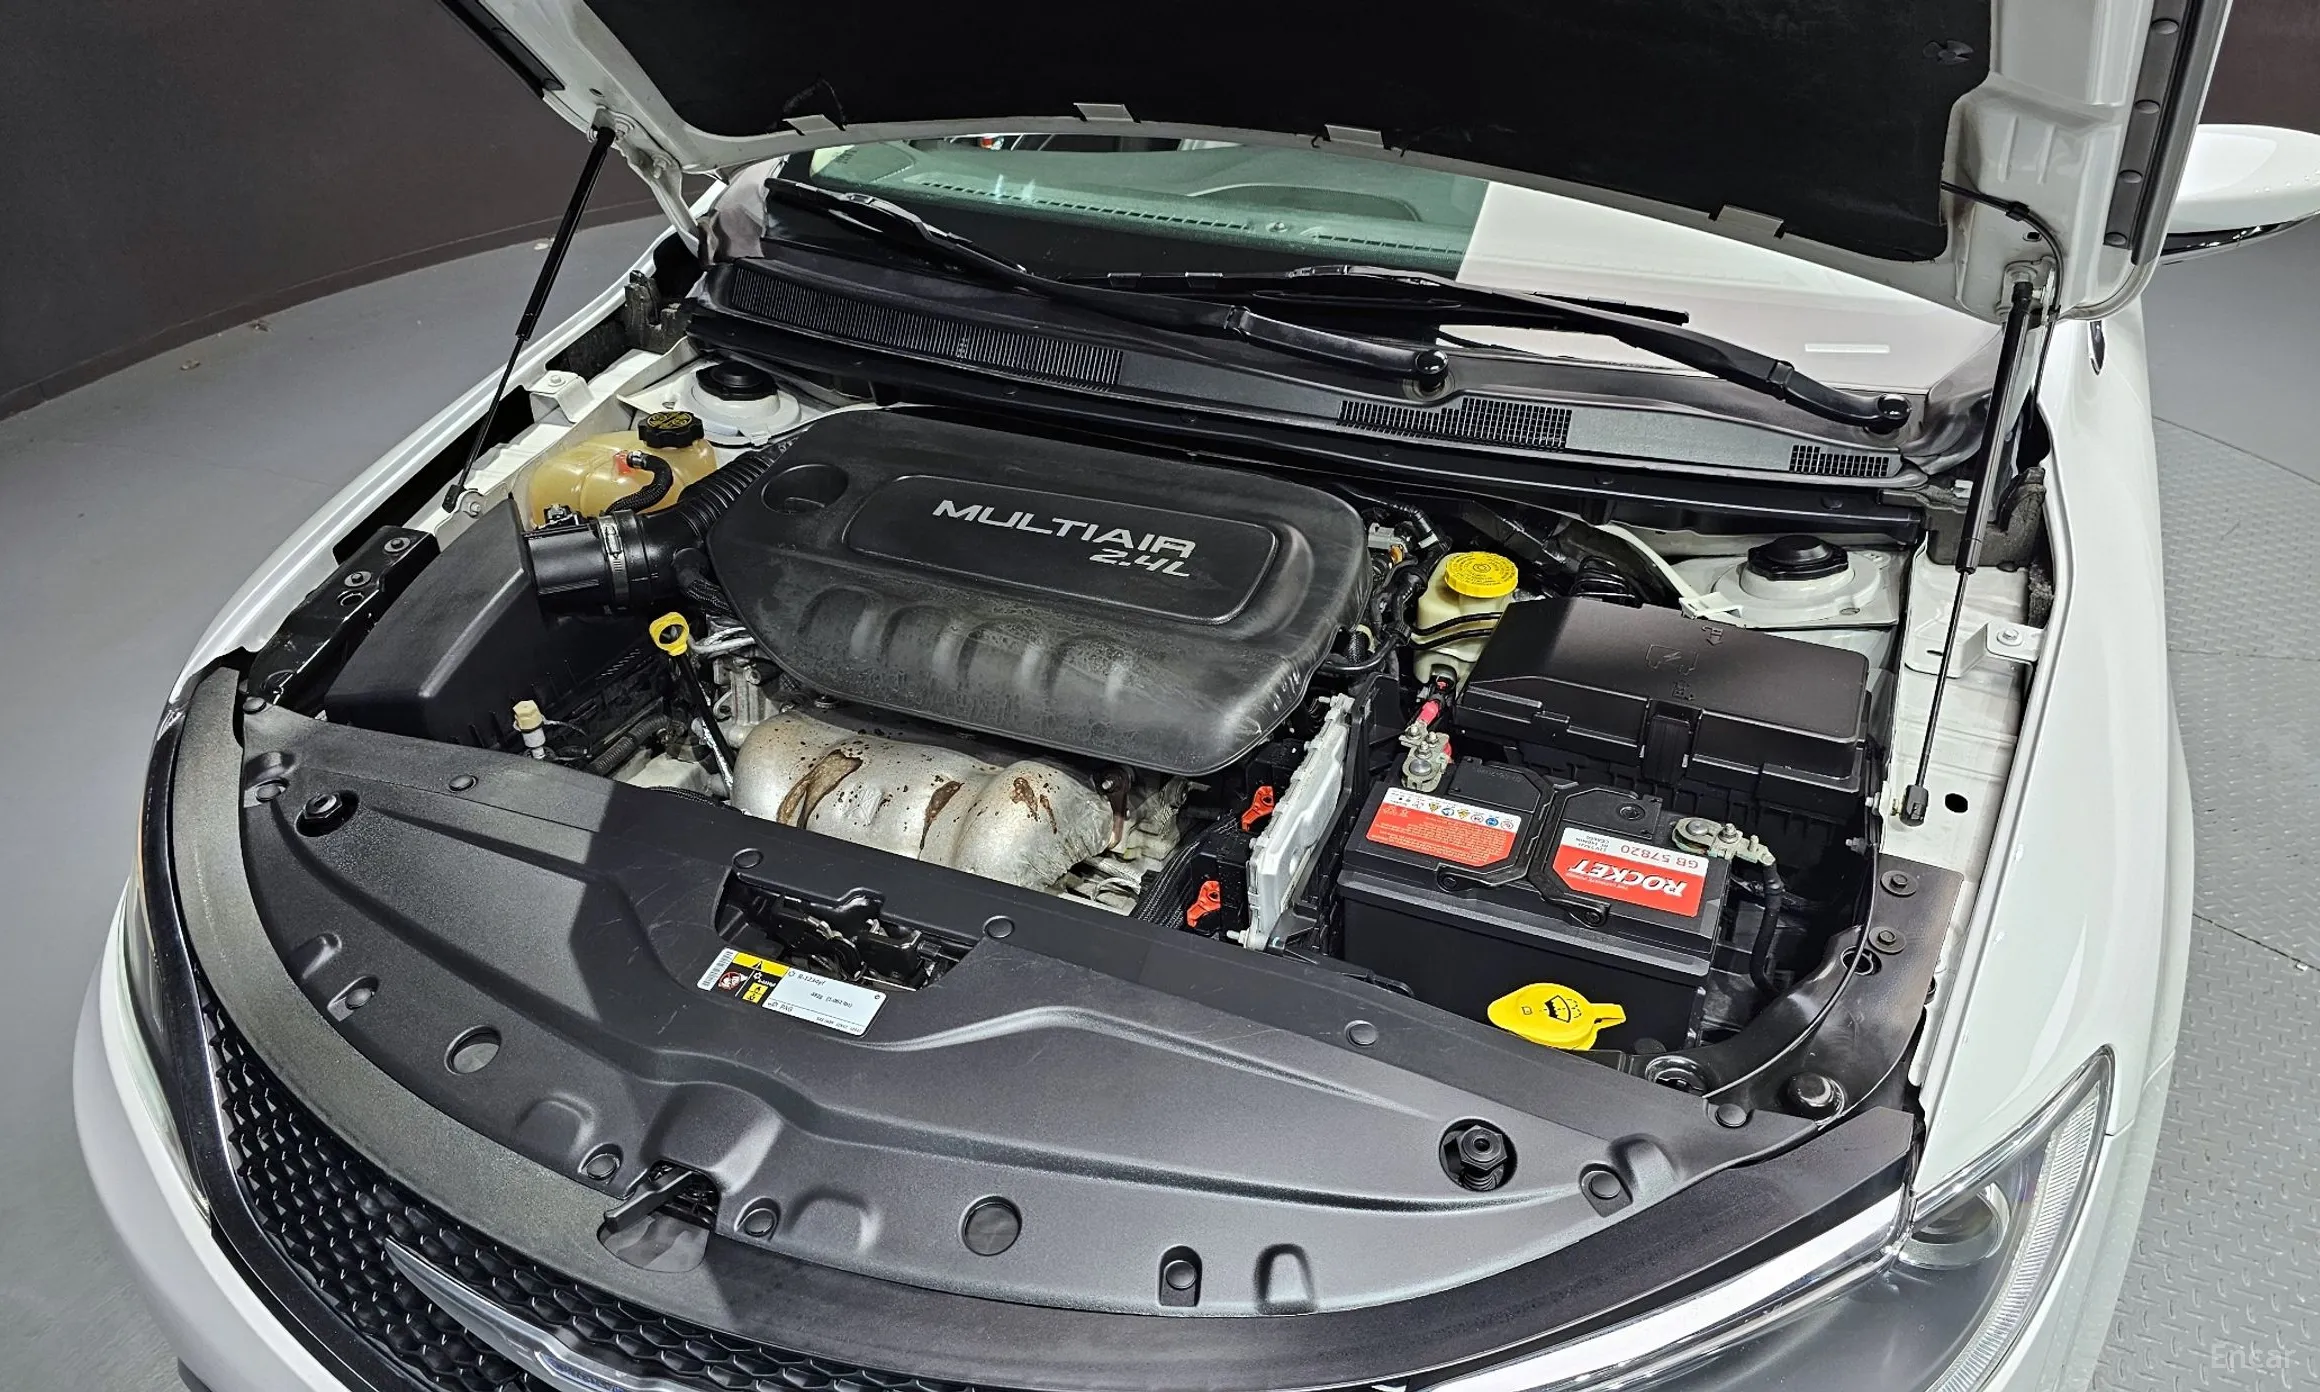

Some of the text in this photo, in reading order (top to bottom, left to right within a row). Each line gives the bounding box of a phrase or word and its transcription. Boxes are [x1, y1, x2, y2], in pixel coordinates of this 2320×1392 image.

[932, 499, 1196, 559] MULTIAIR
[1089, 548, 1190, 577] 2.4L
[1620, 844, 1699, 869] GB 57820
[1567, 858, 1688, 898] ROCKET
